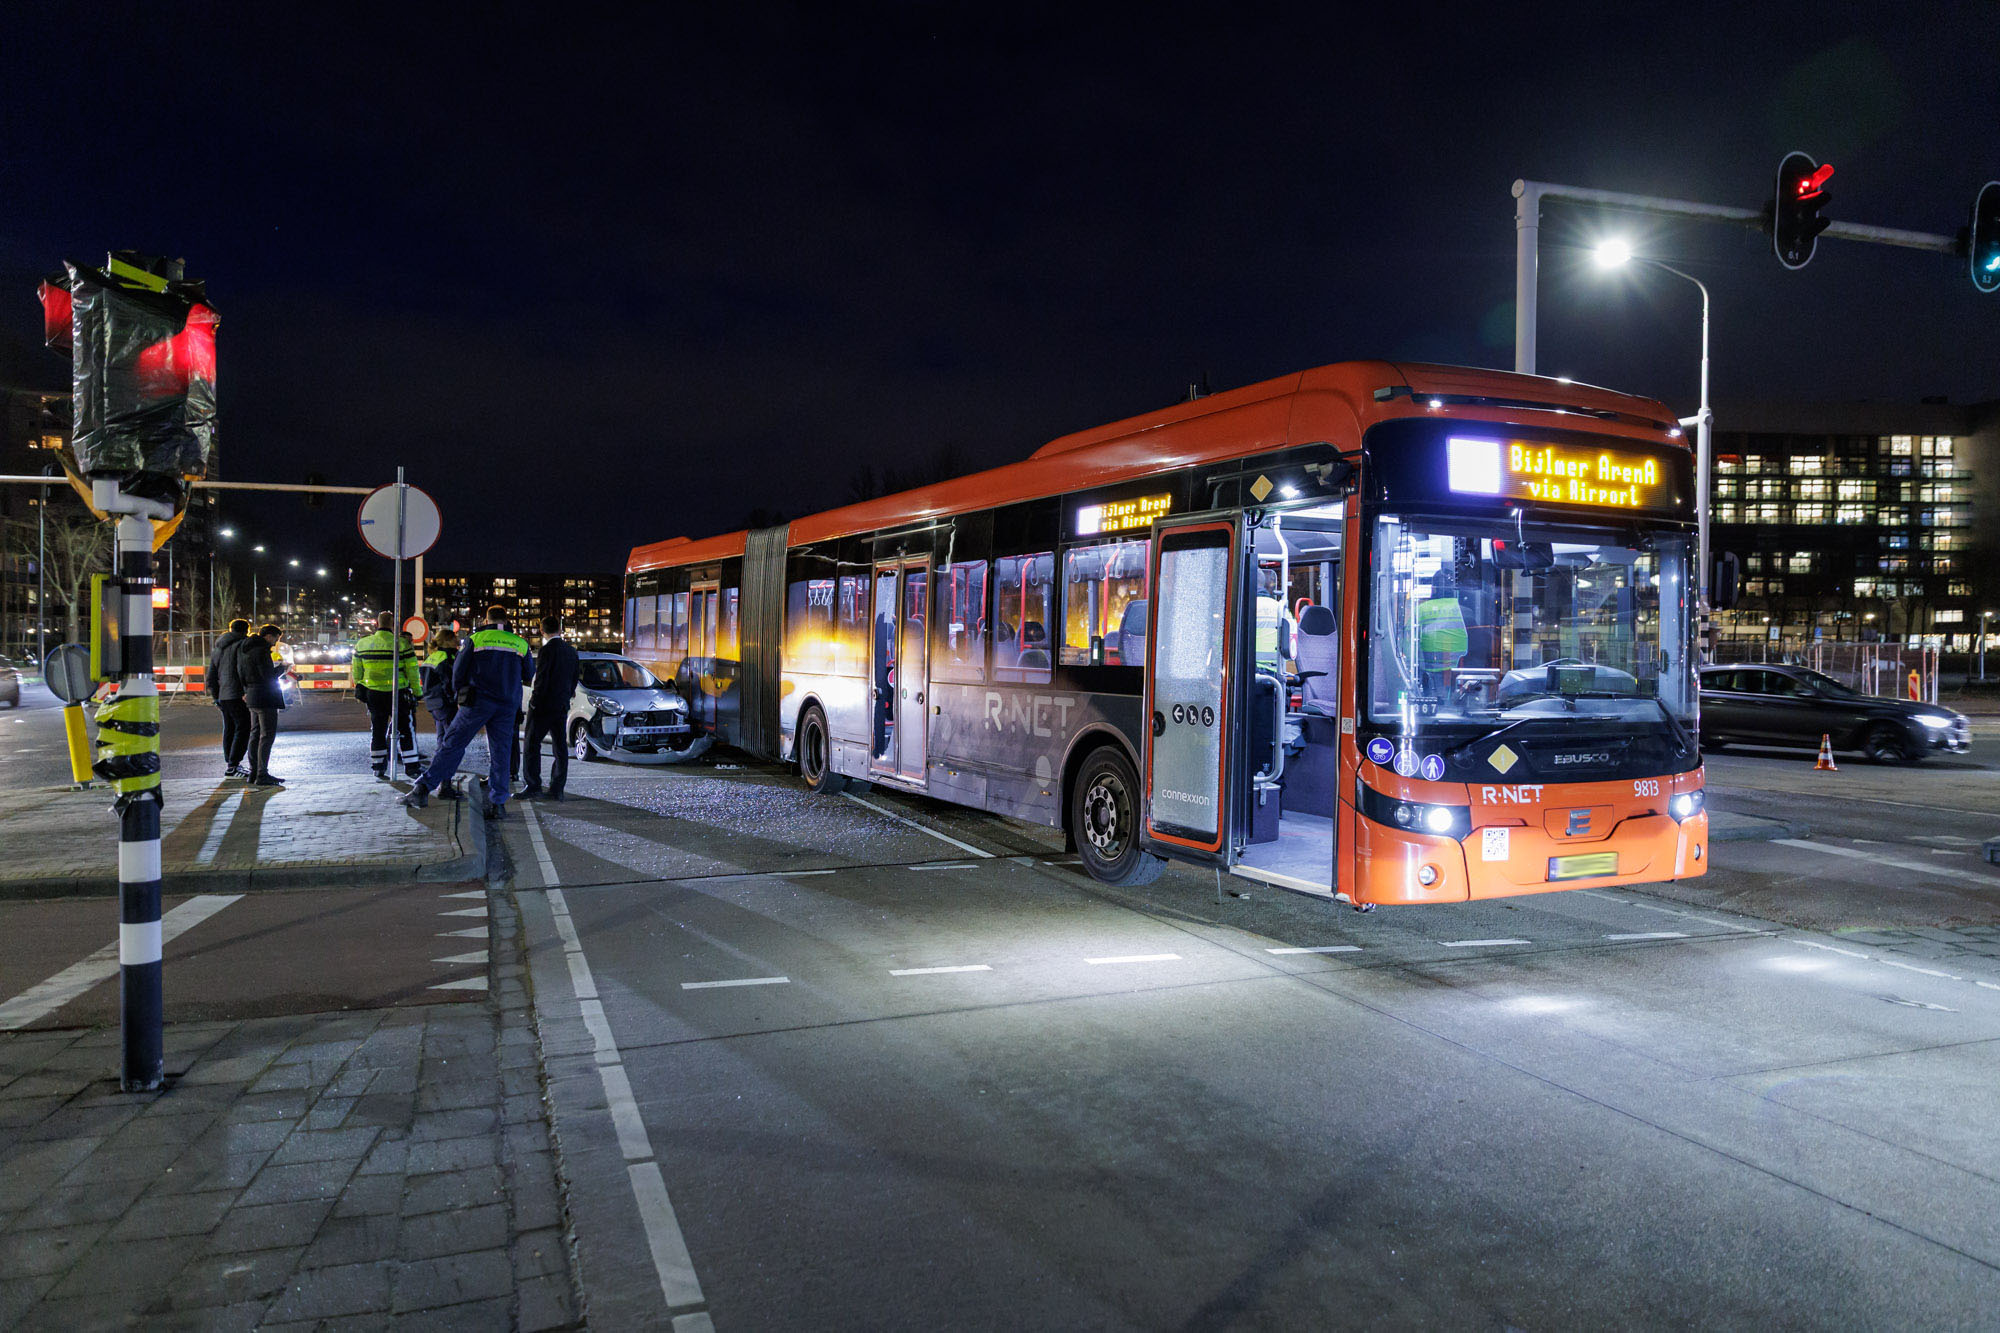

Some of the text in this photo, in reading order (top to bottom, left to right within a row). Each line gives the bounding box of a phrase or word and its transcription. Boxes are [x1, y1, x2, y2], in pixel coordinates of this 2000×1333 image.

[1510, 444, 1656, 486] Bijlmer ArenA
[1529, 478, 1639, 507] via Airport
[1101, 511, 1163, 531] via Airpo
[1553, 753, 1610, 765] EBUSCO
[1161, 789, 1210, 806] connexxion
[1633, 780, 1660, 798] 9813
